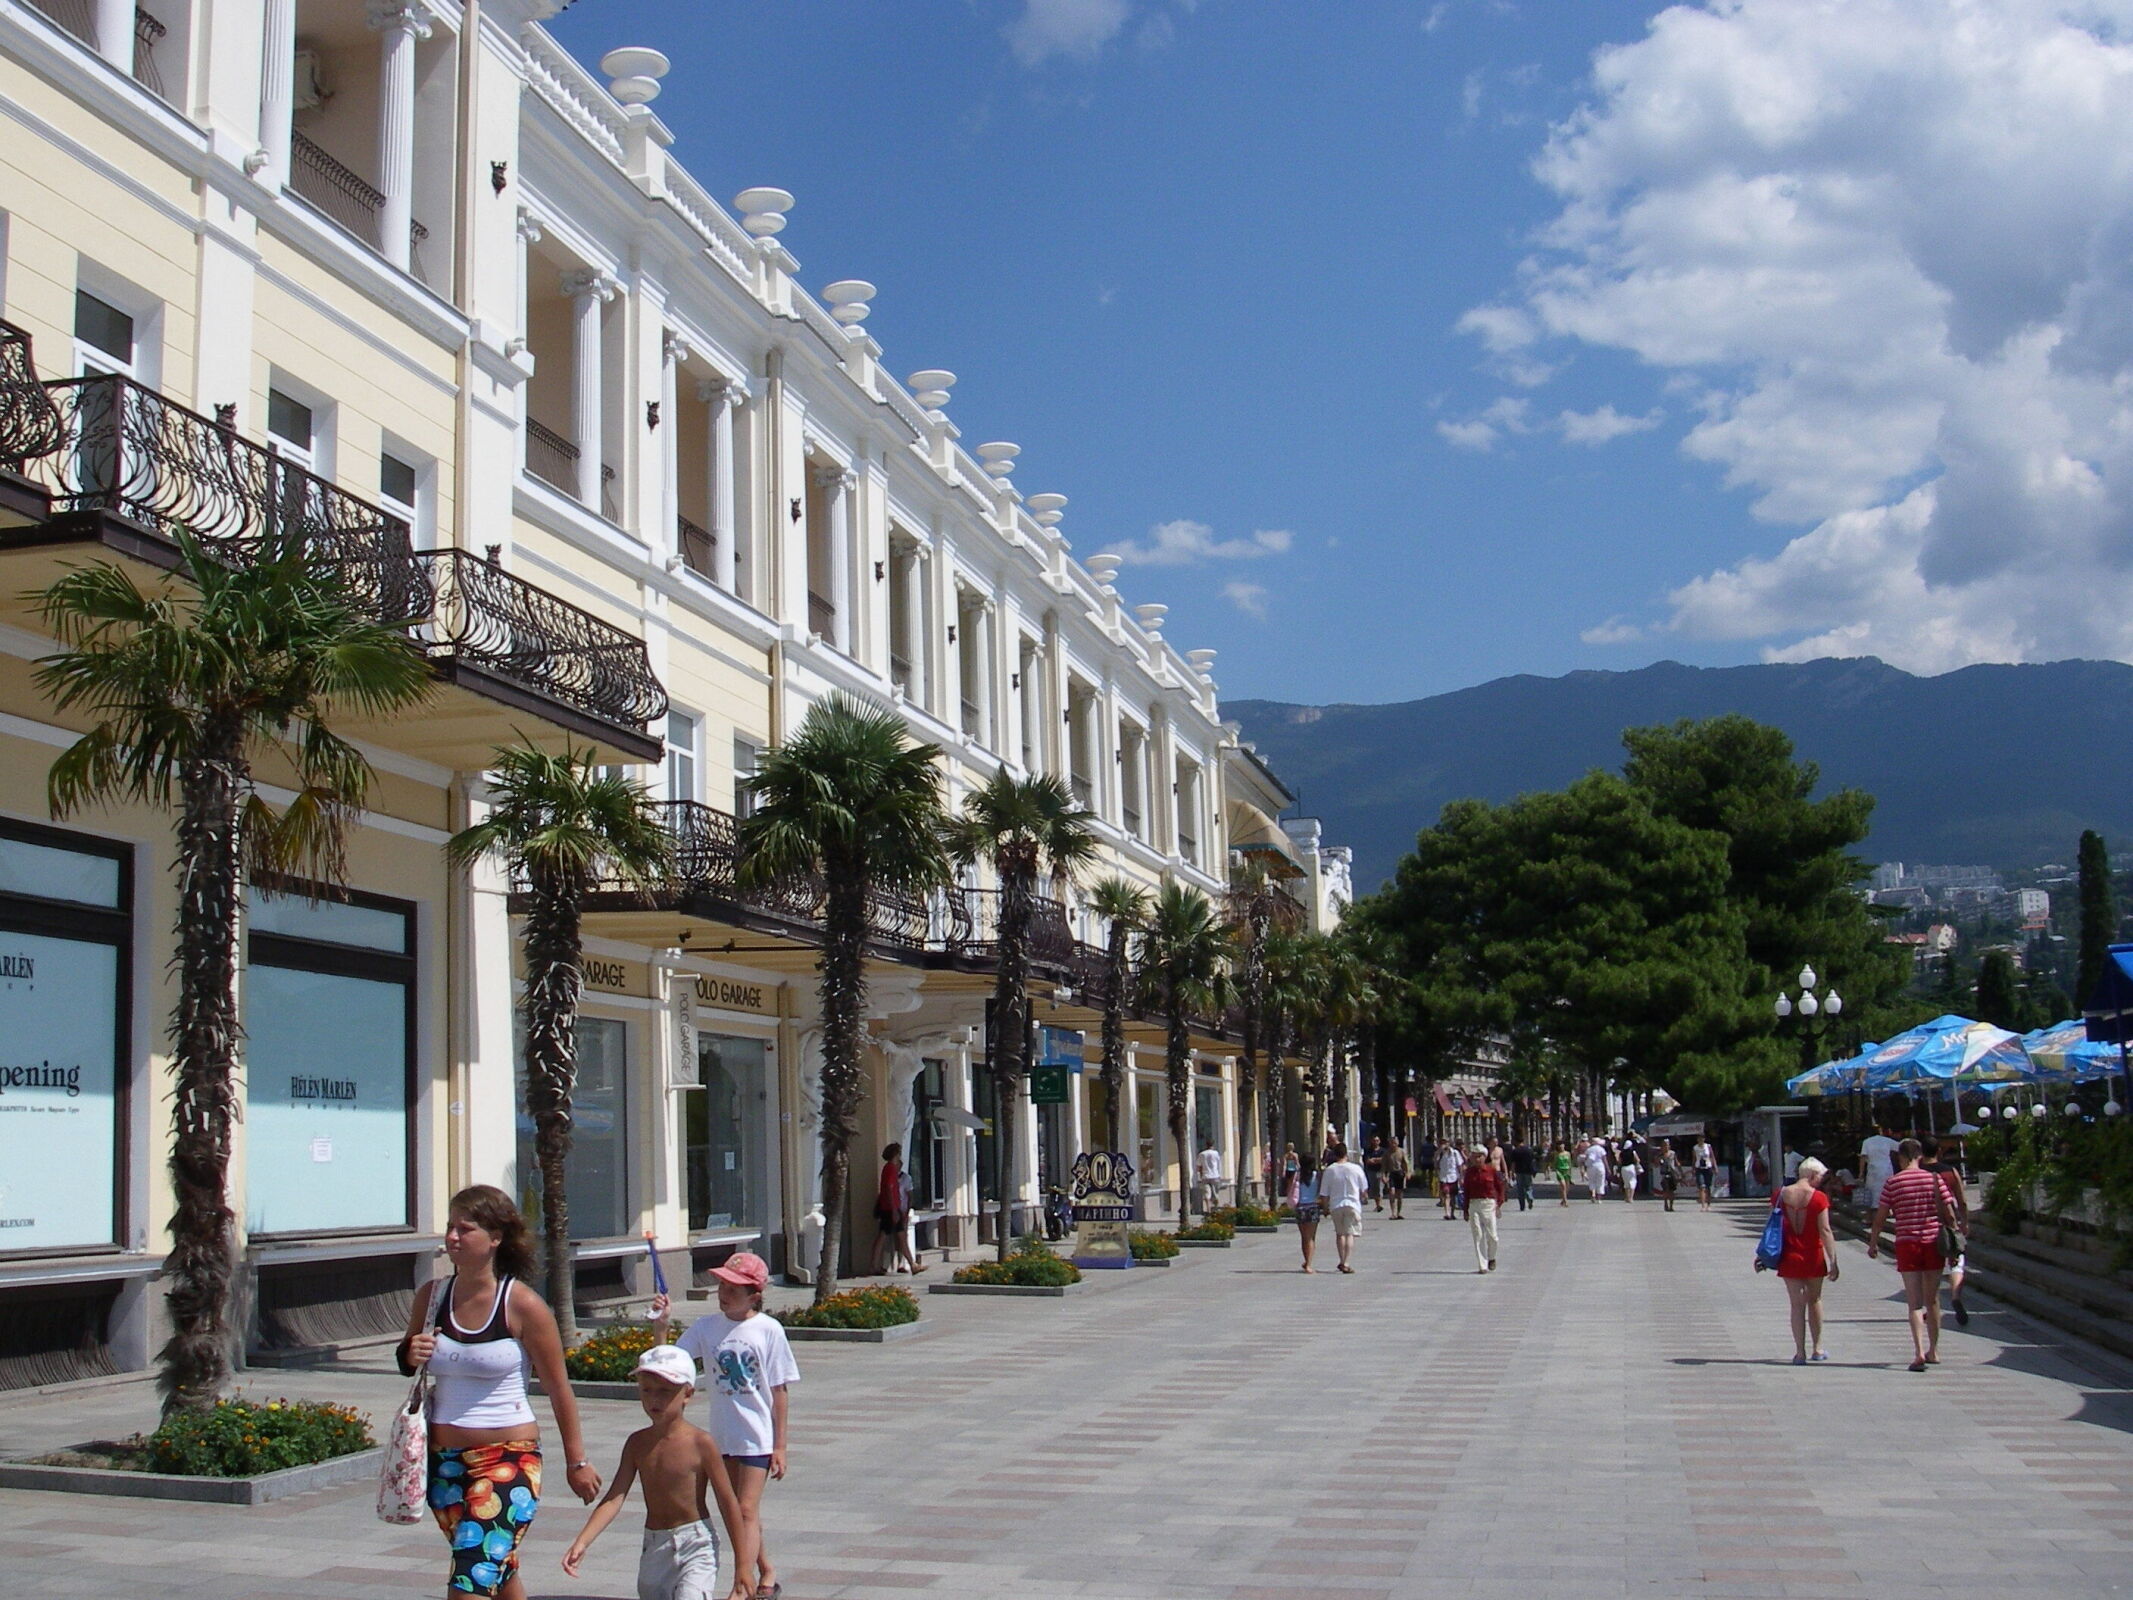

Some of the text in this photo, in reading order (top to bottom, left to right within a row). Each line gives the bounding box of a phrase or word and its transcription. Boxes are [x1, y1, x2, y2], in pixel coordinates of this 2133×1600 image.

[696, 977, 762, 1008] OLO GARAGE
[679, 992, 691, 1072] POLO GARAGE
